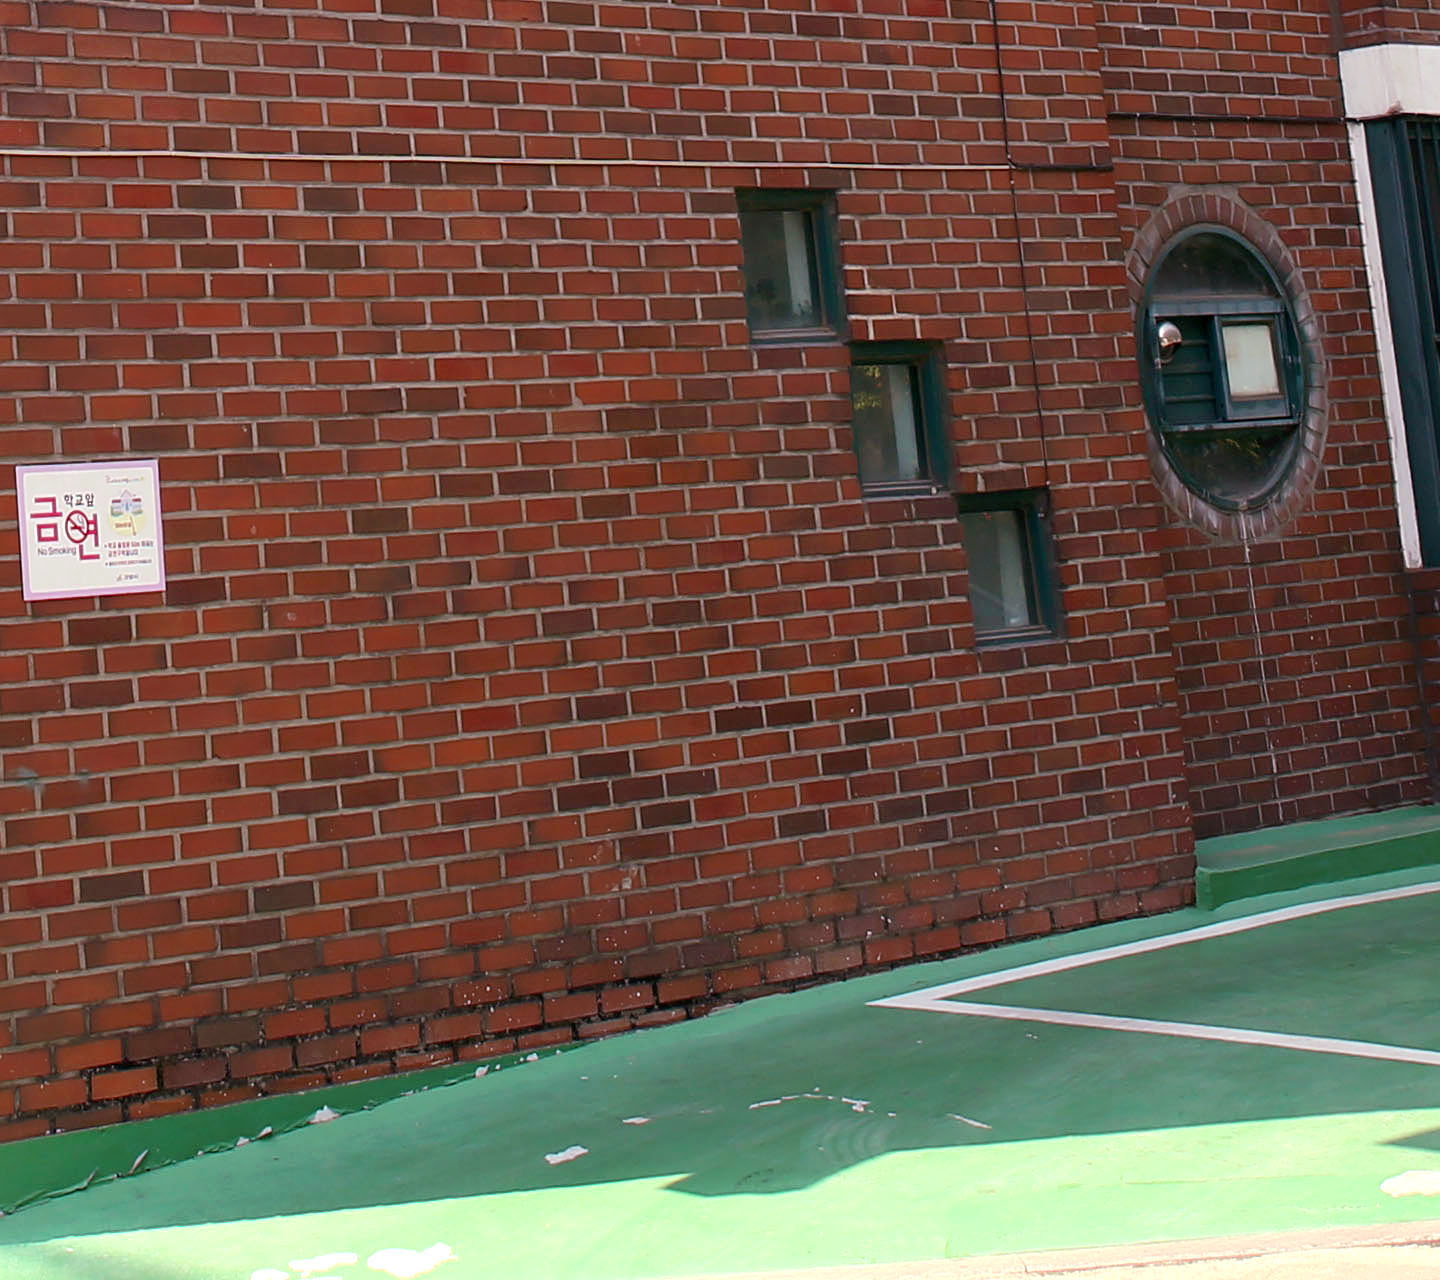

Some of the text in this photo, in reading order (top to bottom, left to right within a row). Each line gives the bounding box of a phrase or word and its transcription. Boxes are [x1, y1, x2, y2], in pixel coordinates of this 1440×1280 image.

[30, 496, 101, 561] 금연
[38, 545, 77, 557] No Smoking
